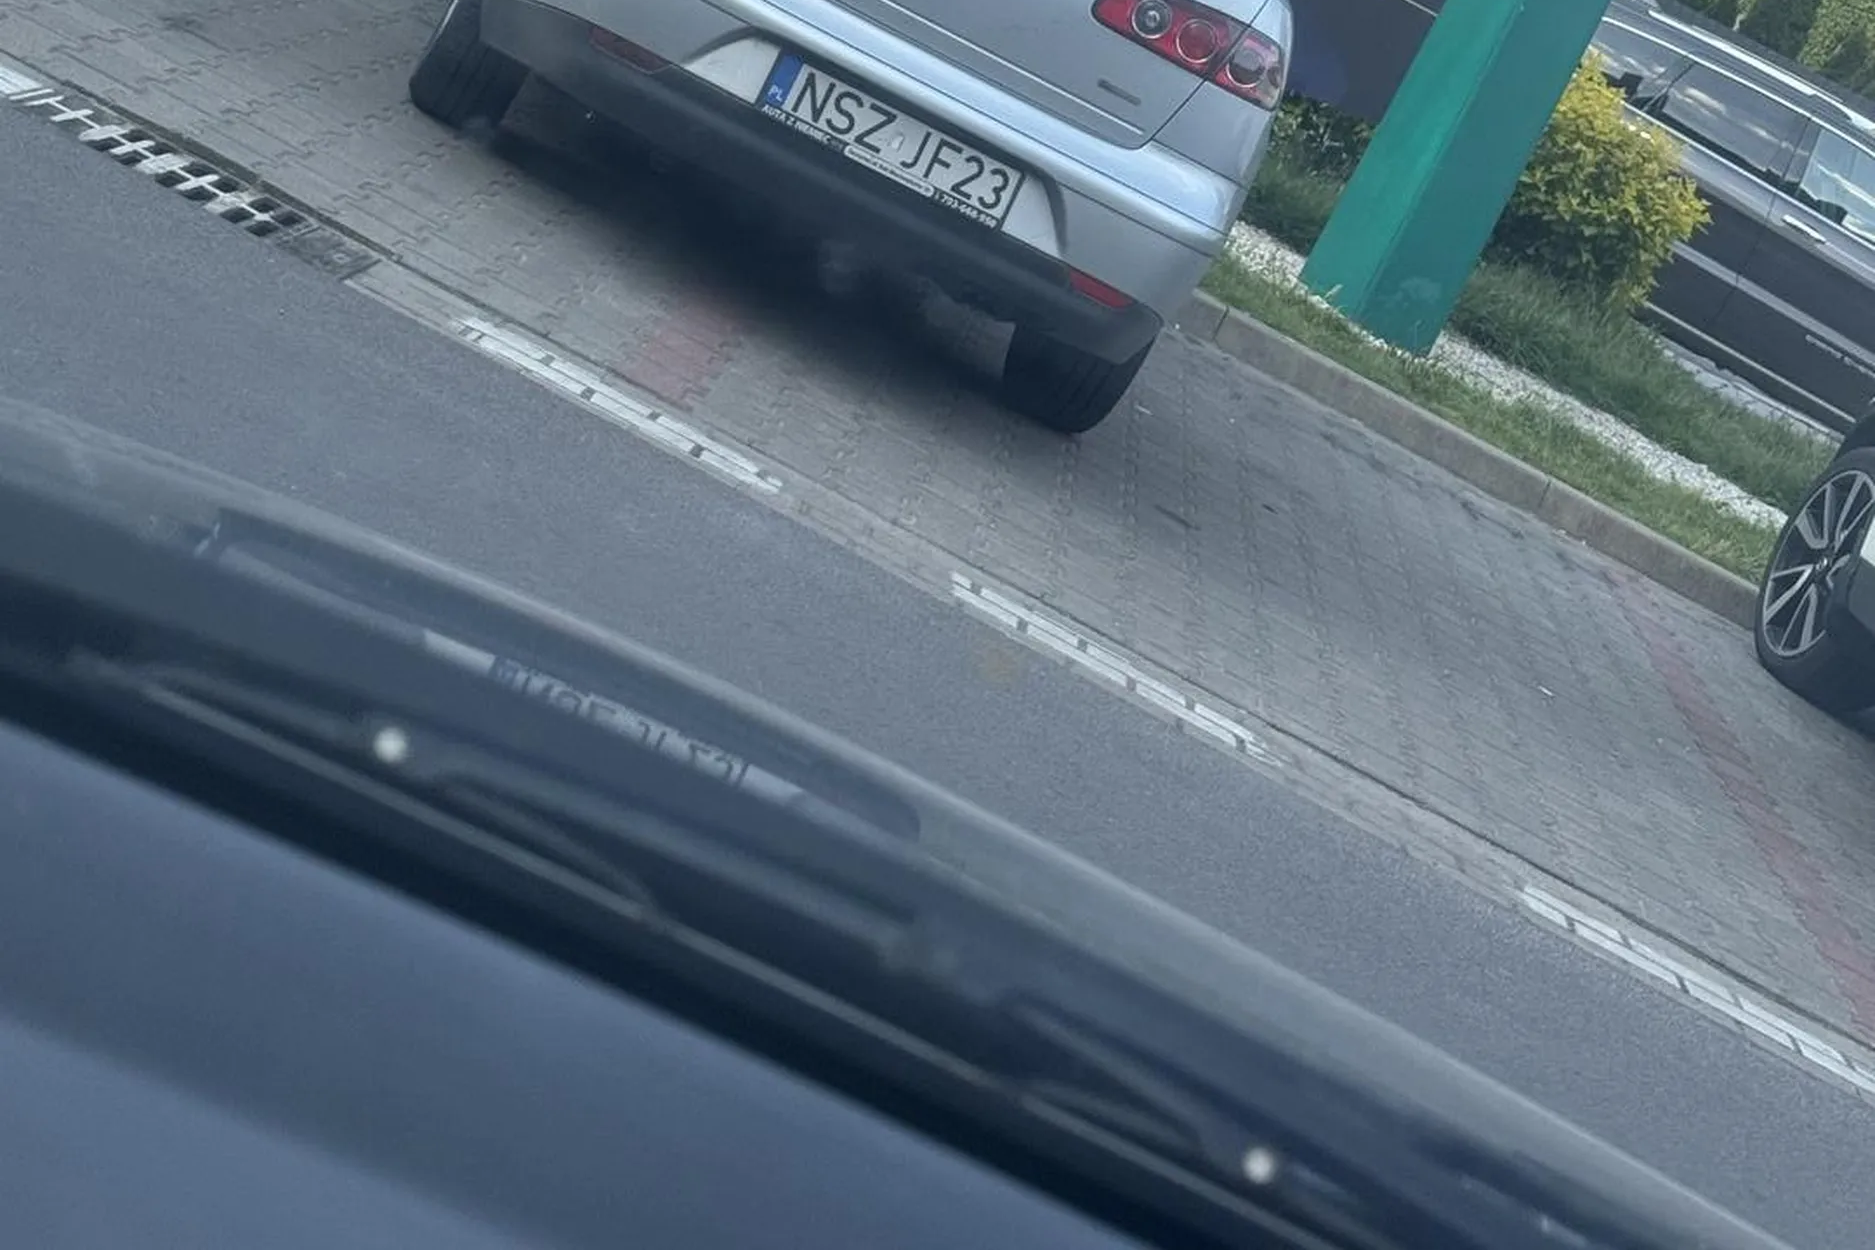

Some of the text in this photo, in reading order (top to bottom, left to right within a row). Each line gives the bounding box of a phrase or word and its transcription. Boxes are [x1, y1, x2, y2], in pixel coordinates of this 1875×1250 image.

[768, 84, 783, 102] PL
[791, 71, 898, 154] NSZ
[900, 130, 1010, 210] JF23
